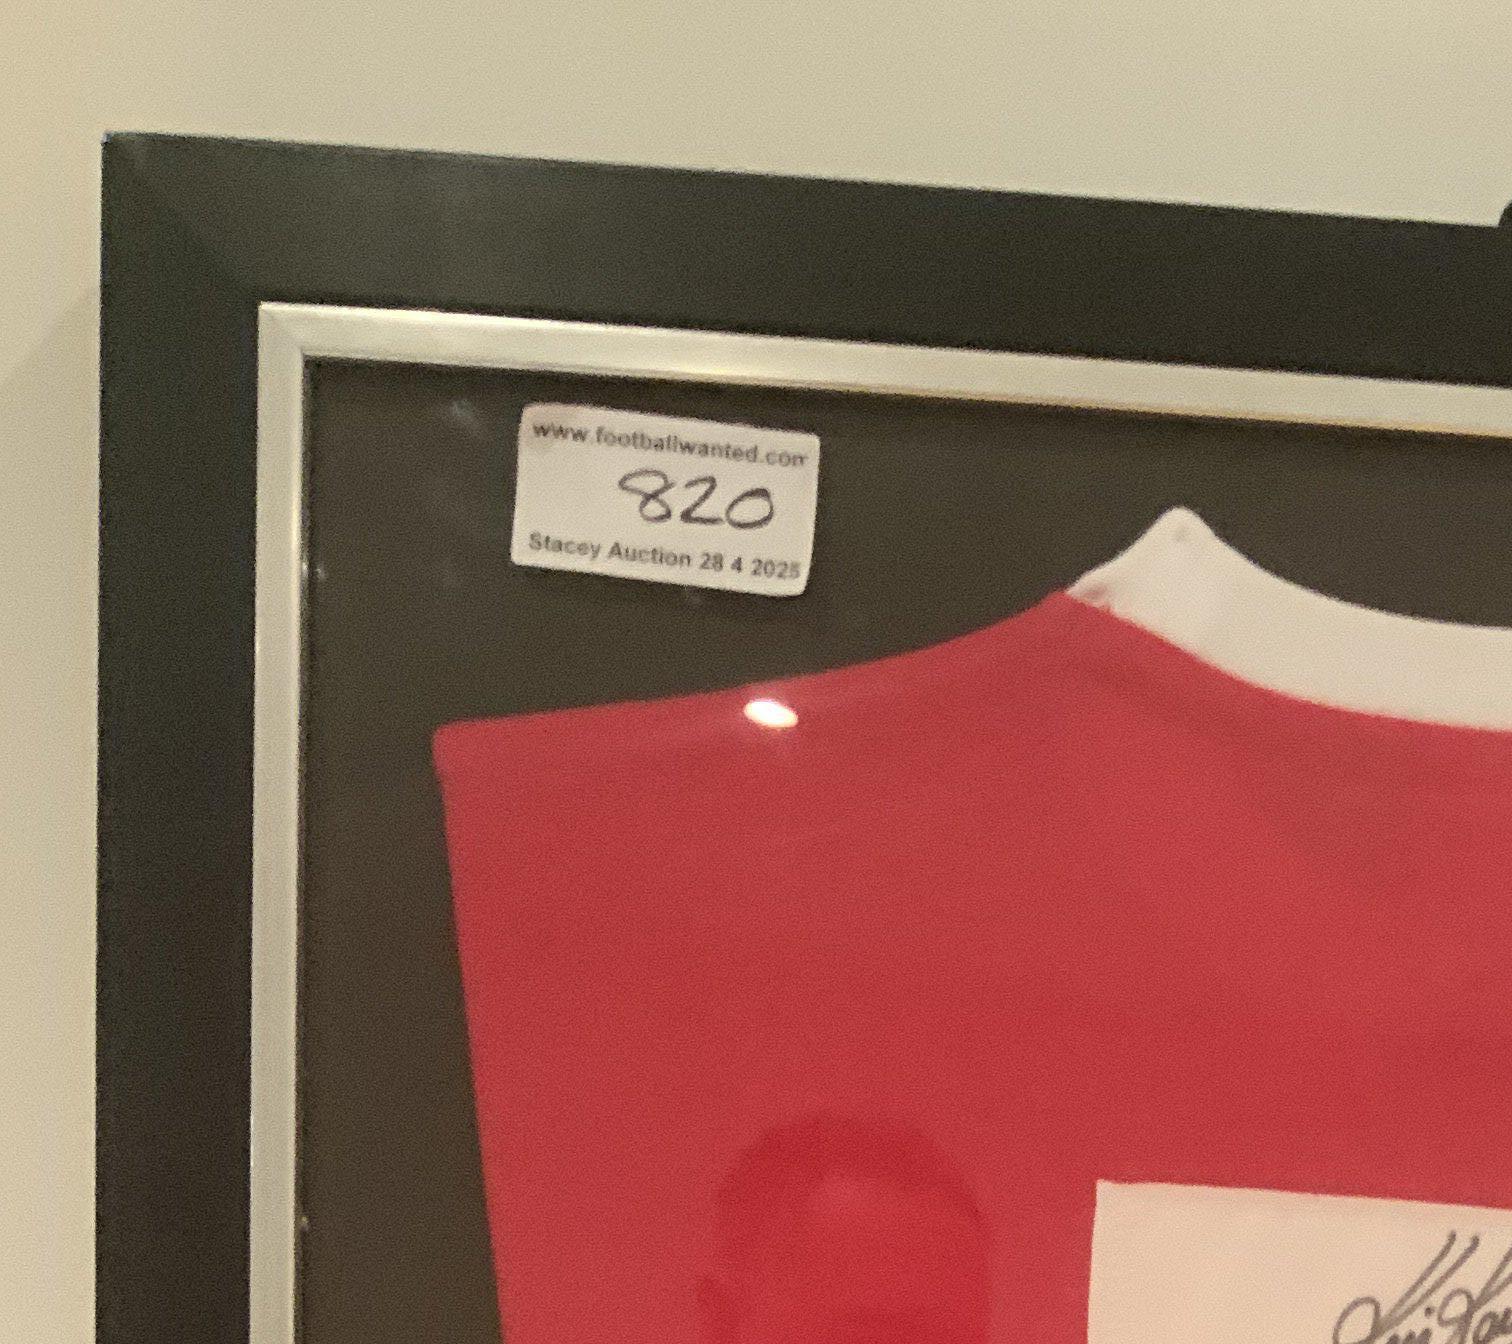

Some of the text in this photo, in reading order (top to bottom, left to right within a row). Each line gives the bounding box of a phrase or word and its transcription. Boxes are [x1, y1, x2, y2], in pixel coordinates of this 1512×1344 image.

[618, 468, 775, 530] 820
[528, 531, 800, 580] Stacey Auction 28 4 2025
